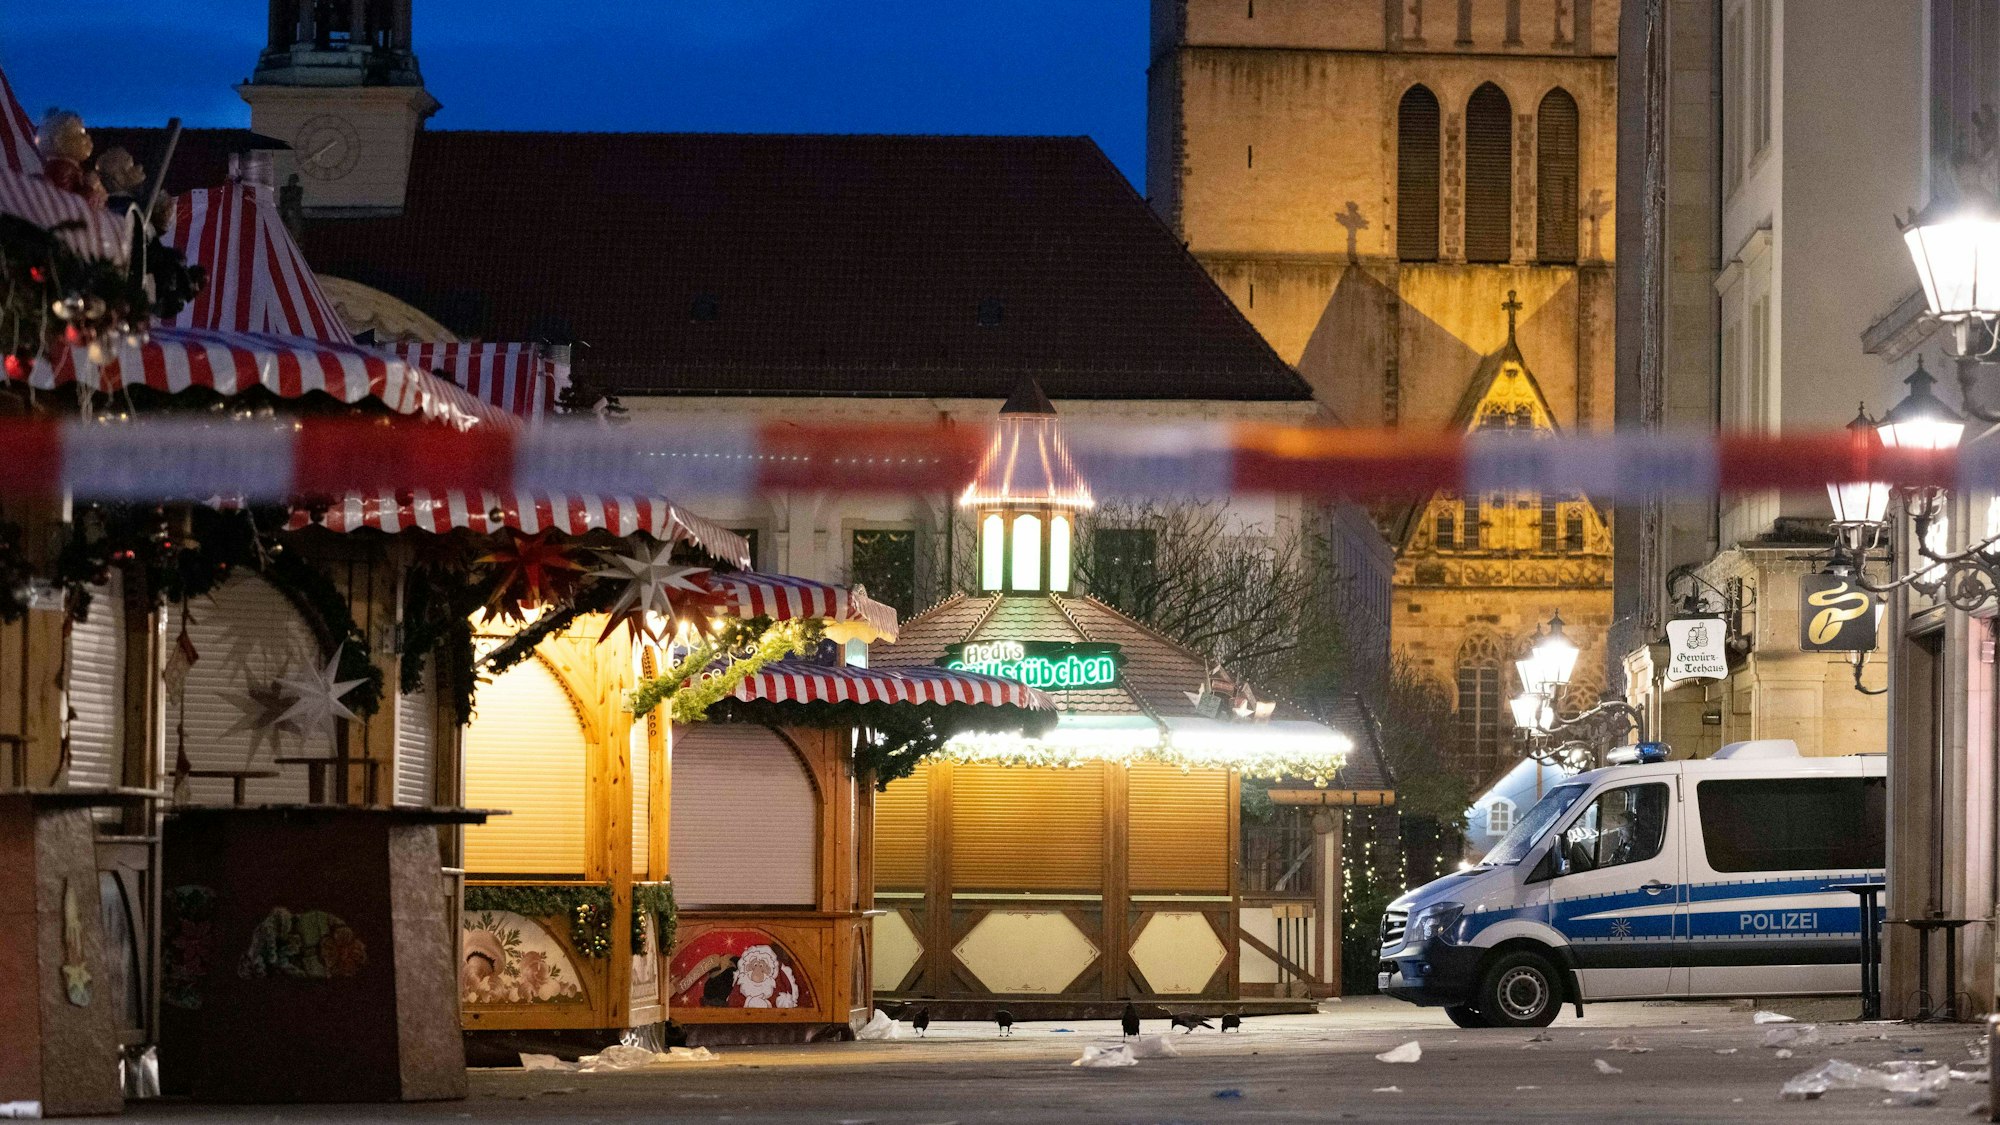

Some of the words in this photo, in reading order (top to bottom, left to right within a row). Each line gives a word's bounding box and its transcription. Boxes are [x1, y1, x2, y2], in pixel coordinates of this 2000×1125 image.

[1677, 652, 1719, 662] Gewürz-
[1685, 664, 1724, 673] Teehaus
[1740, 912, 1818, 930] POLIZEI
